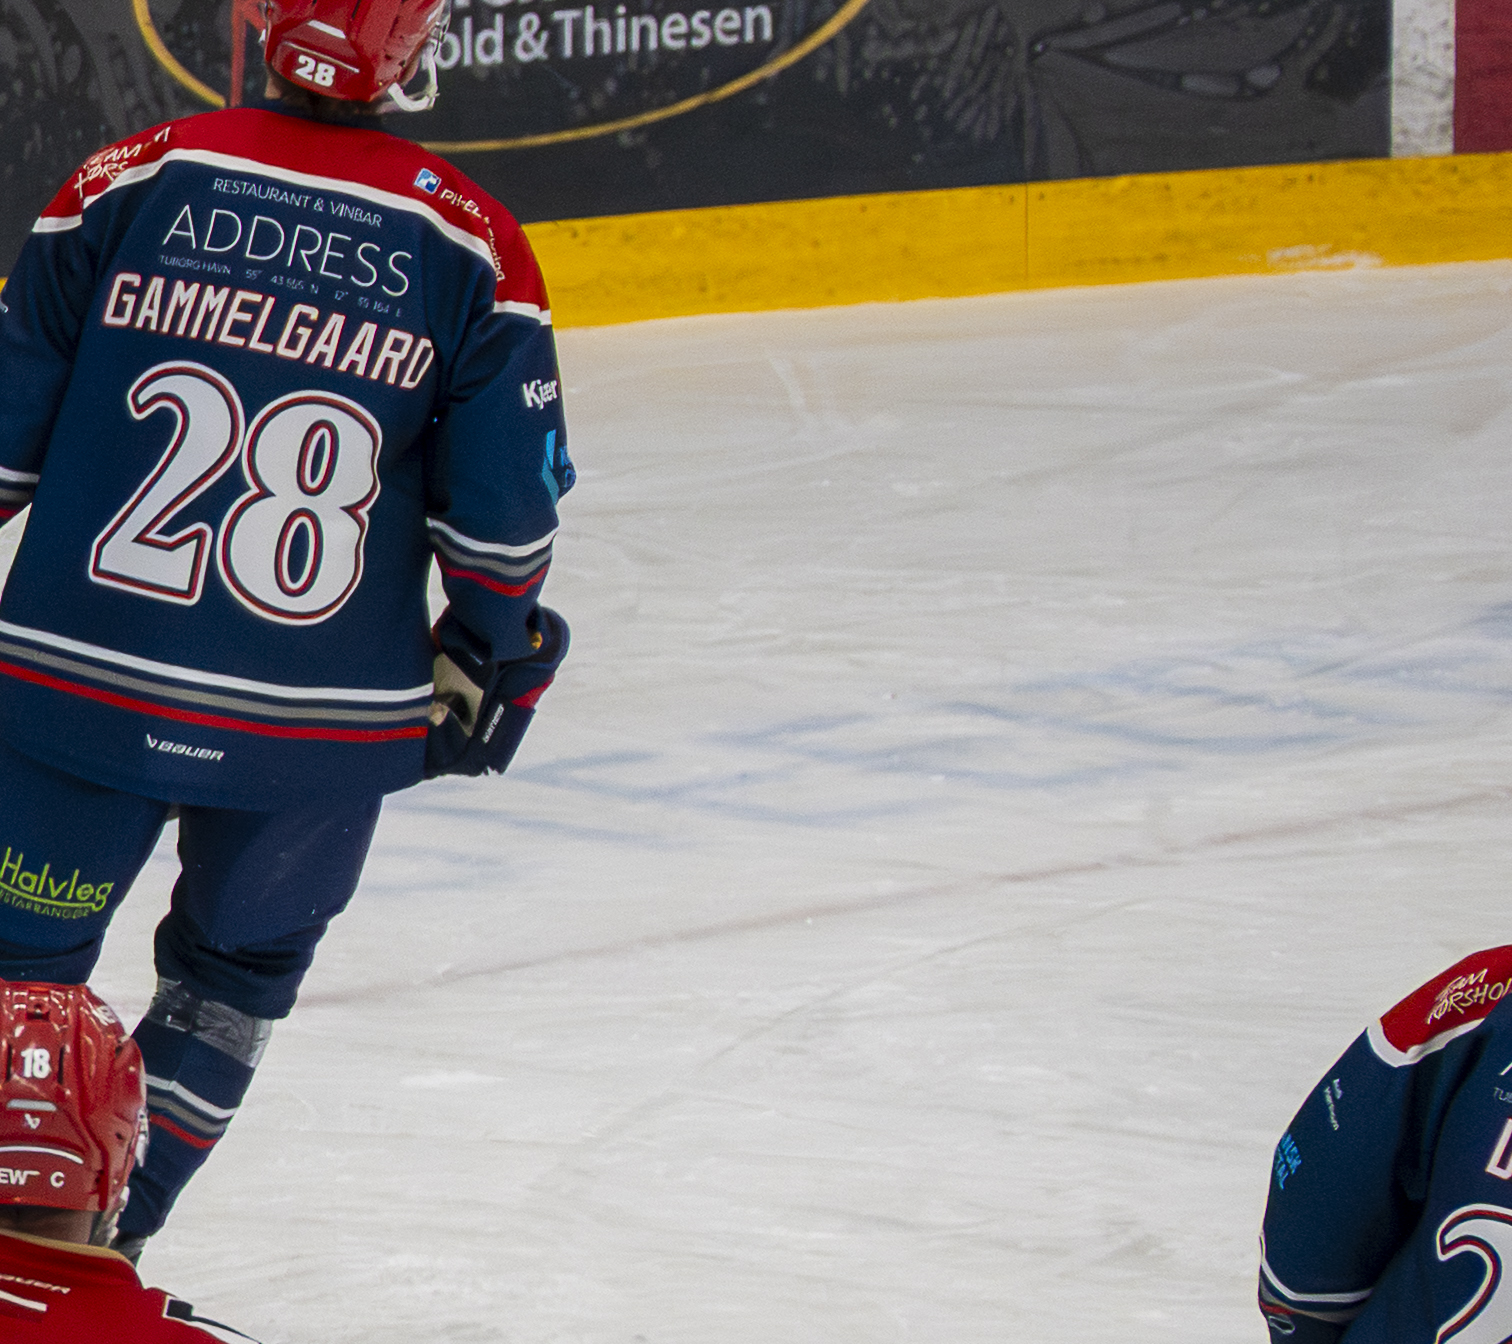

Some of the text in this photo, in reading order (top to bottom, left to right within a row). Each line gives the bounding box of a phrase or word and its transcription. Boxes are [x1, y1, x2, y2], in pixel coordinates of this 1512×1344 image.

[430, 10, 504, 69] old
[513, 8, 549, 64] &
[295, 54, 336, 87] 28
[214, 178, 383, 228] RESTAURANT & VINBAR
[162, 204, 413, 297] ADDRESS
[103, 271, 435, 390] GAMMELGAARD
[88, 358, 383, 626] 28
[158, 740, 225, 762] BAUER
[21, 1047, 52, 1079] 18
